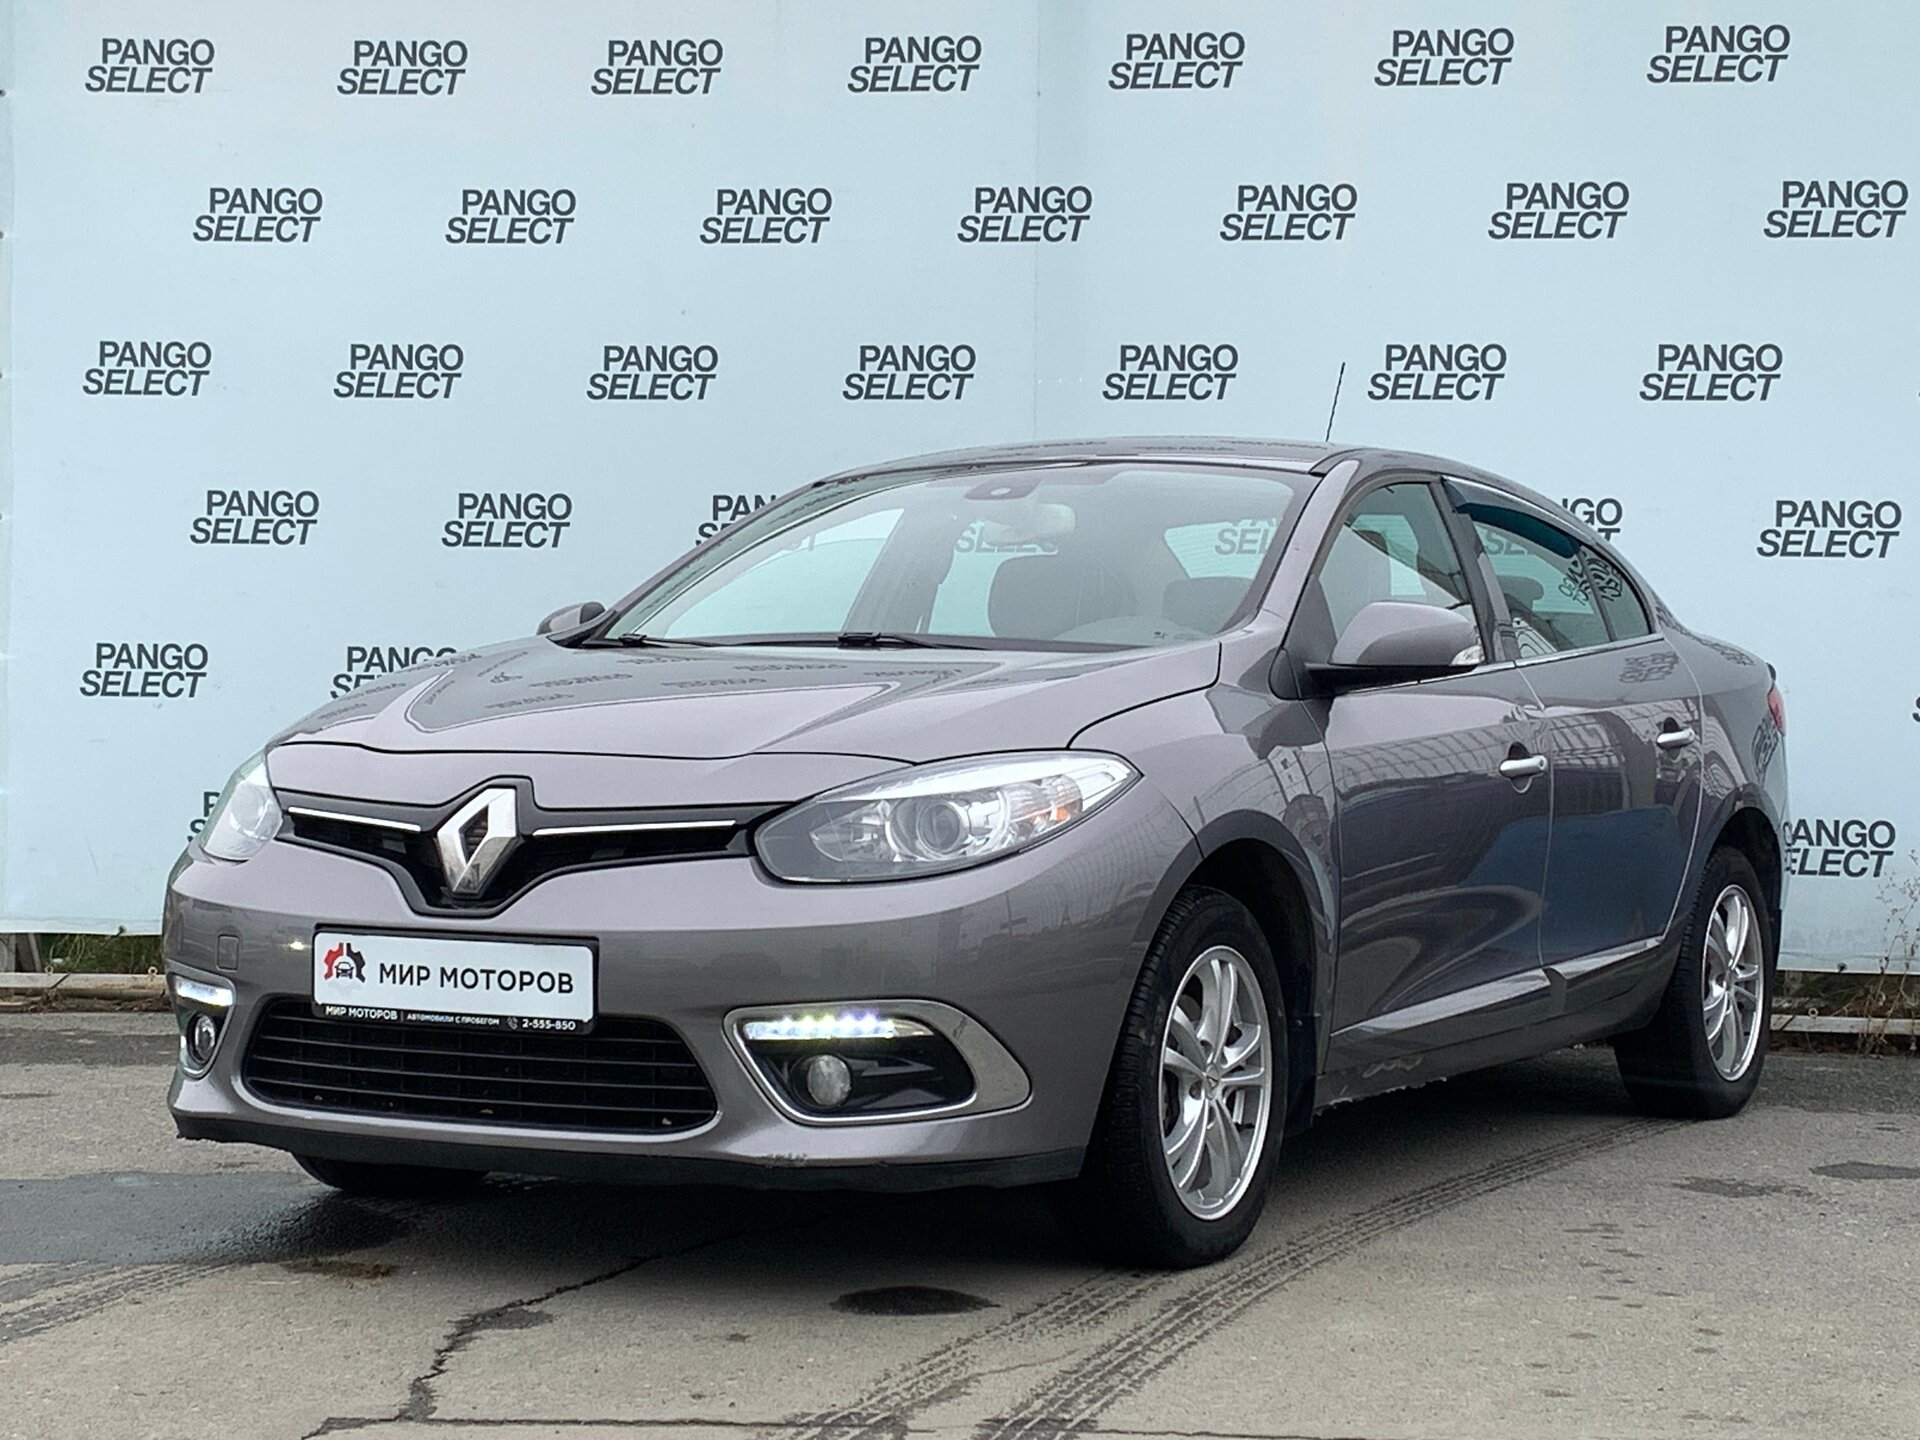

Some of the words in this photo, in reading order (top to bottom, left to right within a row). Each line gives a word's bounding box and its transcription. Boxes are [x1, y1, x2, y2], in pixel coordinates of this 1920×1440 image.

[102, 37, 215, 66] PANGO
[353, 39, 468, 68] PANGO
[607, 38, 724, 67] PANGO
[865, 35, 982, 65] PANGO
[1125, 31, 1246, 61] PANGO
[1392, 27, 1515, 58] PANGO
[1665, 24, 1791, 54] PANGO
[84, 65, 213, 94] SELECT
[336, 67, 467, 96] SELECT
[590, 67, 722, 96] SELECT
[847, 63, 980, 93] SELECT
[1108, 60, 1244, 90] SELECT
[1374, 57, 1513, 87] SELECT
[1646, 53, 1789, 84] SELECT
[209, 187, 323, 215] PANGO
[462, 188, 577, 217] PANGO
[716, 187, 833, 216] PANGO
[974, 185, 1093, 214] PANGO
[1237, 183, 1358, 212] PANGO
[1506, 181, 1630, 211] PANGO
[1782, 179, 1909, 209] PANGO
[192, 214, 322, 243] SELECT
[445, 216, 575, 245] SELECT
[699, 216, 831, 245] SELECT
[957, 214, 1091, 243] SELECT
[1219, 212, 1356, 242] SELECT
[1487, 210, 1628, 240] SELECT
[1763, 209, 1907, 239] SELECT
[99, 340, 212, 369] PANGO
[350, 343, 464, 372] PANGO
[603, 344, 719, 373] PANGO
[859, 344, 977, 373] PANGO
[1119, 343, 1239, 372] PANGO
[1385, 343, 1507, 372] PANGO
[1657, 343, 1783, 373] PANGO
[82, 368, 211, 397] SELECT
[333, 371, 462, 399] SELECT
[586, 372, 717, 401] SELECT
[842, 372, 975, 401] SELECT
[1102, 372, 1237, 401] SELECT
[1367, 372, 1506, 401] SELECT
[1639, 372, 1782, 402] SELECT
[206, 489, 320, 518] PANGO
[458, 492, 573, 521] PANGO
[1775, 499, 1902, 529] PANGO
[189, 517, 318, 546] SELECT
[441, 520, 571, 549] SELECT
[1756, 528, 1901, 559] SELECT
[95, 642, 209, 671] PANGO
[79, 669, 208, 698] SELECT
[1790, 818, 1896, 849] ANGO
[379, 963, 431, 986] МИР
[439, 966, 574, 994] МОТОРОВ
[325, 1005, 347, 1016] МИР
[348, 1007, 398, 1020] МОТОРОВ
[522, 1018, 577, 1031] 2-555-850
